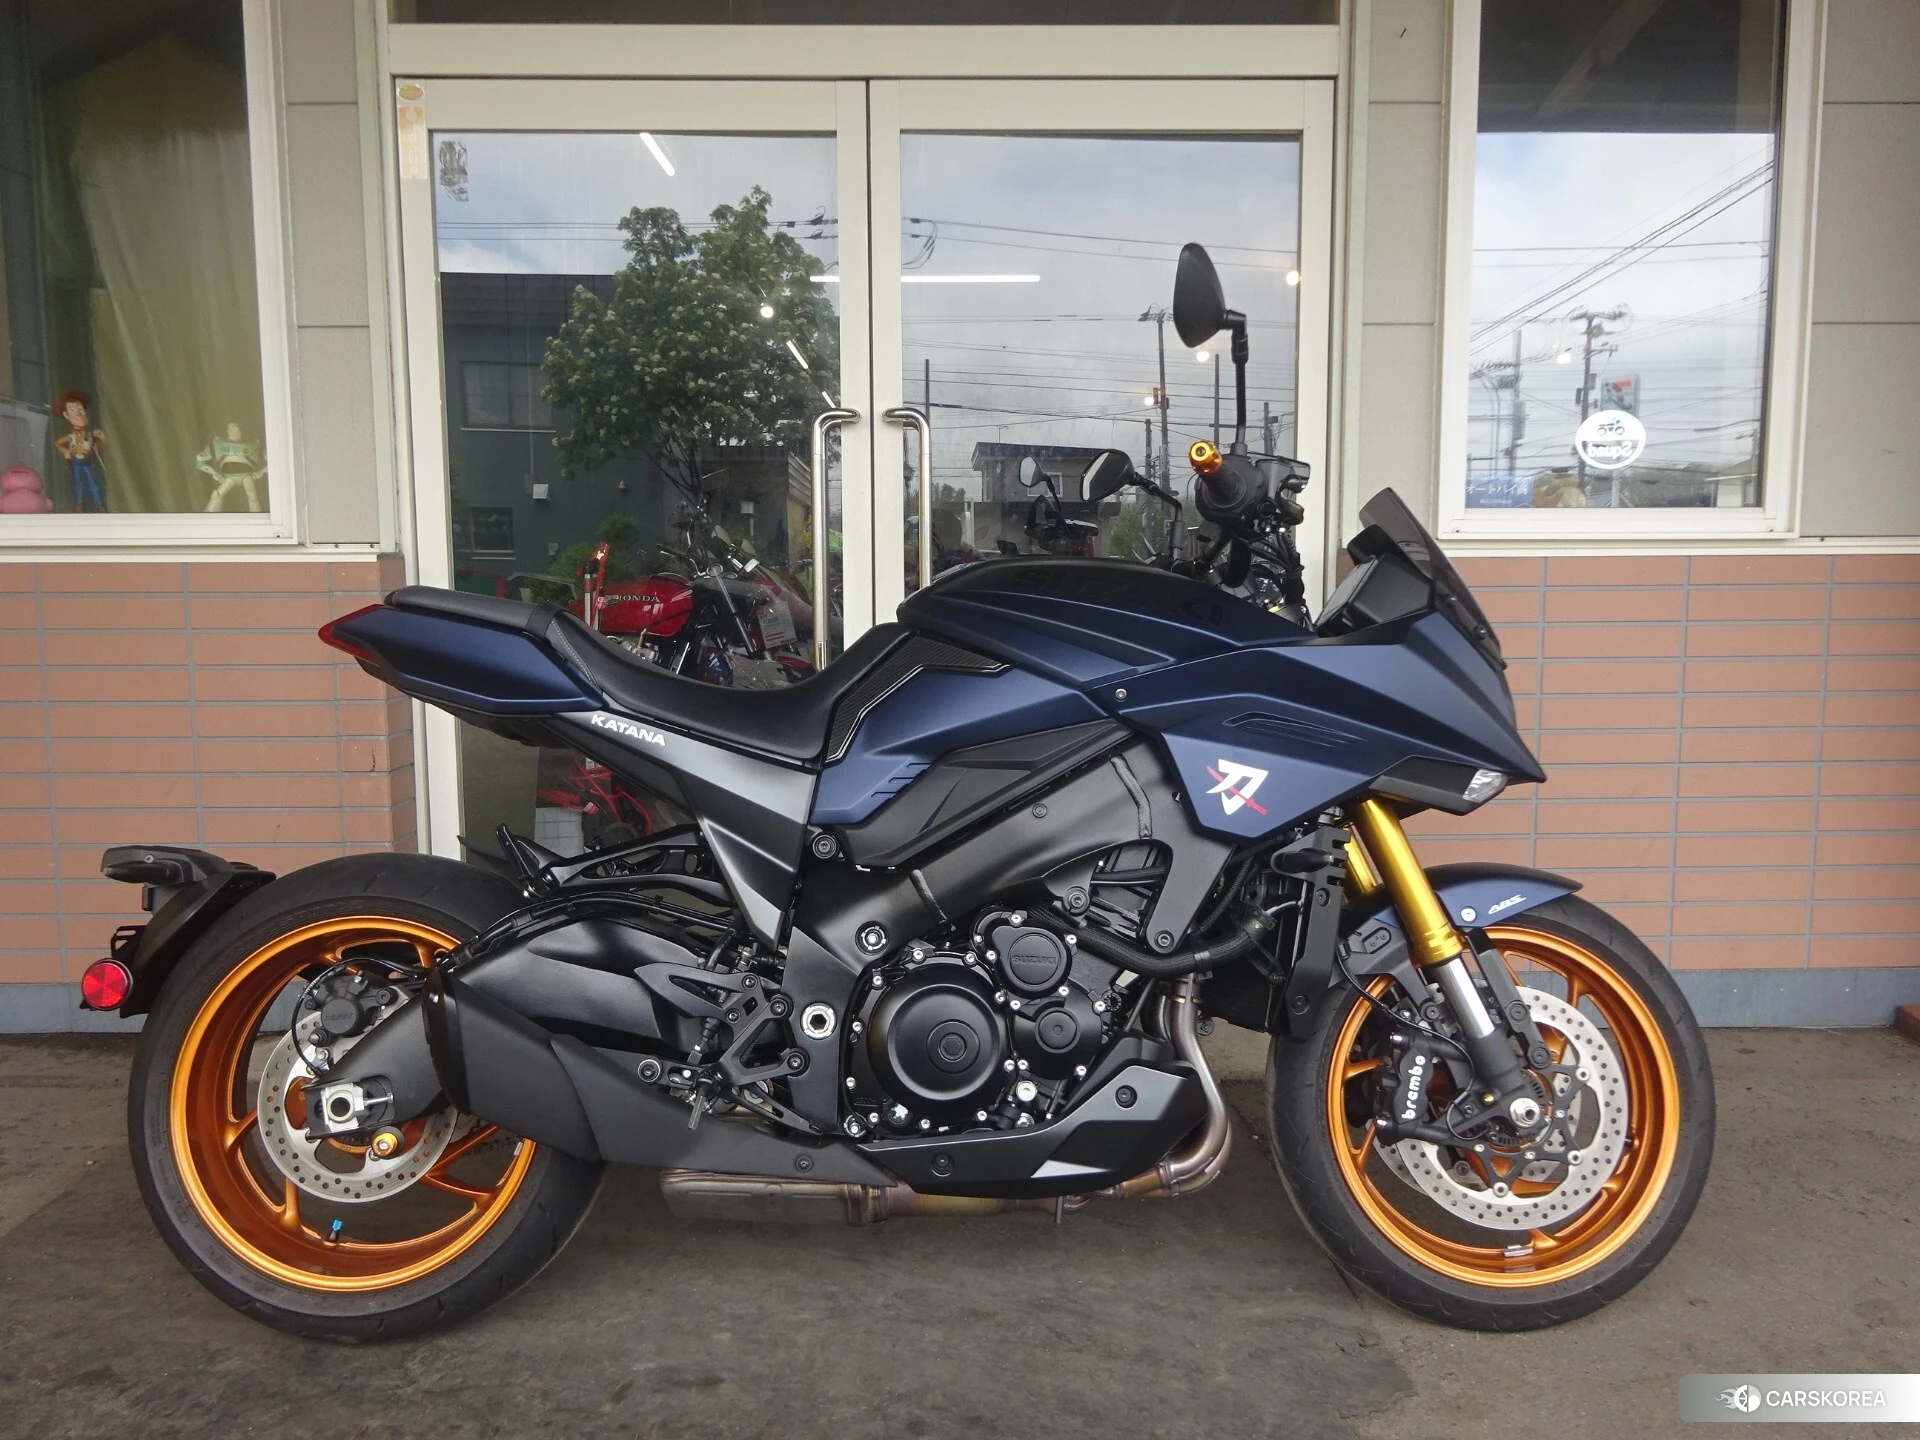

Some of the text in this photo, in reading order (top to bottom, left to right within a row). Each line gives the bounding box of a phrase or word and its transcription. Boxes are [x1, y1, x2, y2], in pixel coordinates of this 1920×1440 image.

[591, 714, 666, 746] KATANA
[1488, 894, 1527, 915] ABS
[1012, 954, 1057, 965] SUZUKI
[1401, 1055, 1426, 1119] brembo
